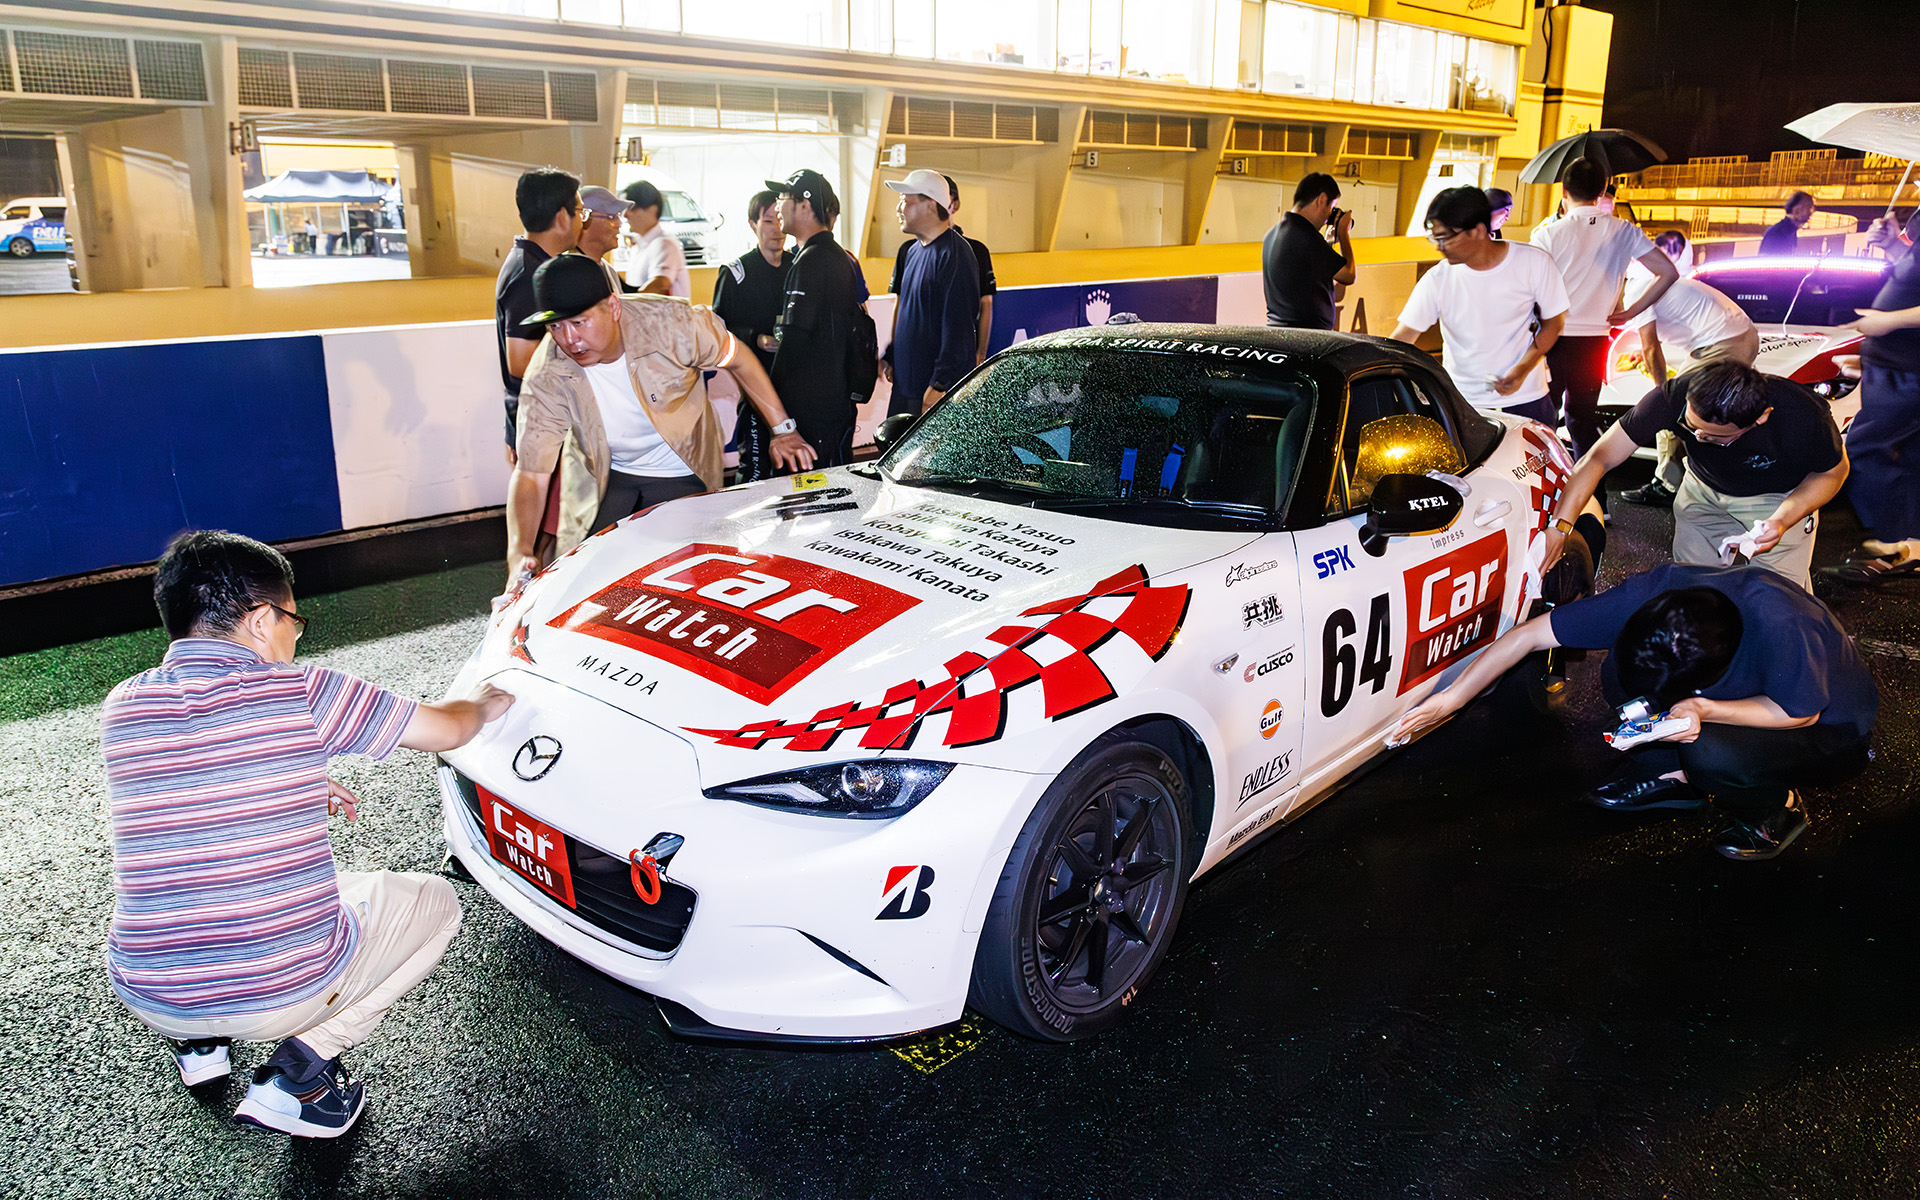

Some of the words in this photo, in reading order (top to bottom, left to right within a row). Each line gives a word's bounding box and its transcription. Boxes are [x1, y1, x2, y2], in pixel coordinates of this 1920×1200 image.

[1090, 152, 1096, 166] 5
[1237, 160, 1243, 172] 3
[1108, 338, 1182, 351] SPIRIT
[1186, 341, 1288, 365] RACING
[1408, 495, 1449, 511] KTEL
[978, 528, 1060, 557] Kazuya
[1010, 522, 1077, 547] Yasuo
[1430, 528, 1466, 550] impress
[803, 539, 912, 574] Kawakami
[907, 567, 991, 602] Kanata
[833, 528, 919, 556] Ishikawa
[922, 549, 1004, 584] Takuya
[969, 543, 1060, 577] Takashi
[1313, 544, 1356, 580] SPK
[642, 552, 859, 623] Car
[1418, 557, 1500, 633] Car
[613, 594, 758, 661] Watch
[1426, 613, 1484, 667] Watch
[1320, 591, 1393, 718] 64
[576, 655, 660, 696] MAZDA
[1260, 710, 1283, 730] Gulf
[1238, 748, 1293, 802] ENDLESS
[492, 801, 554, 862] Car
[505, 841, 553, 888] Watch
